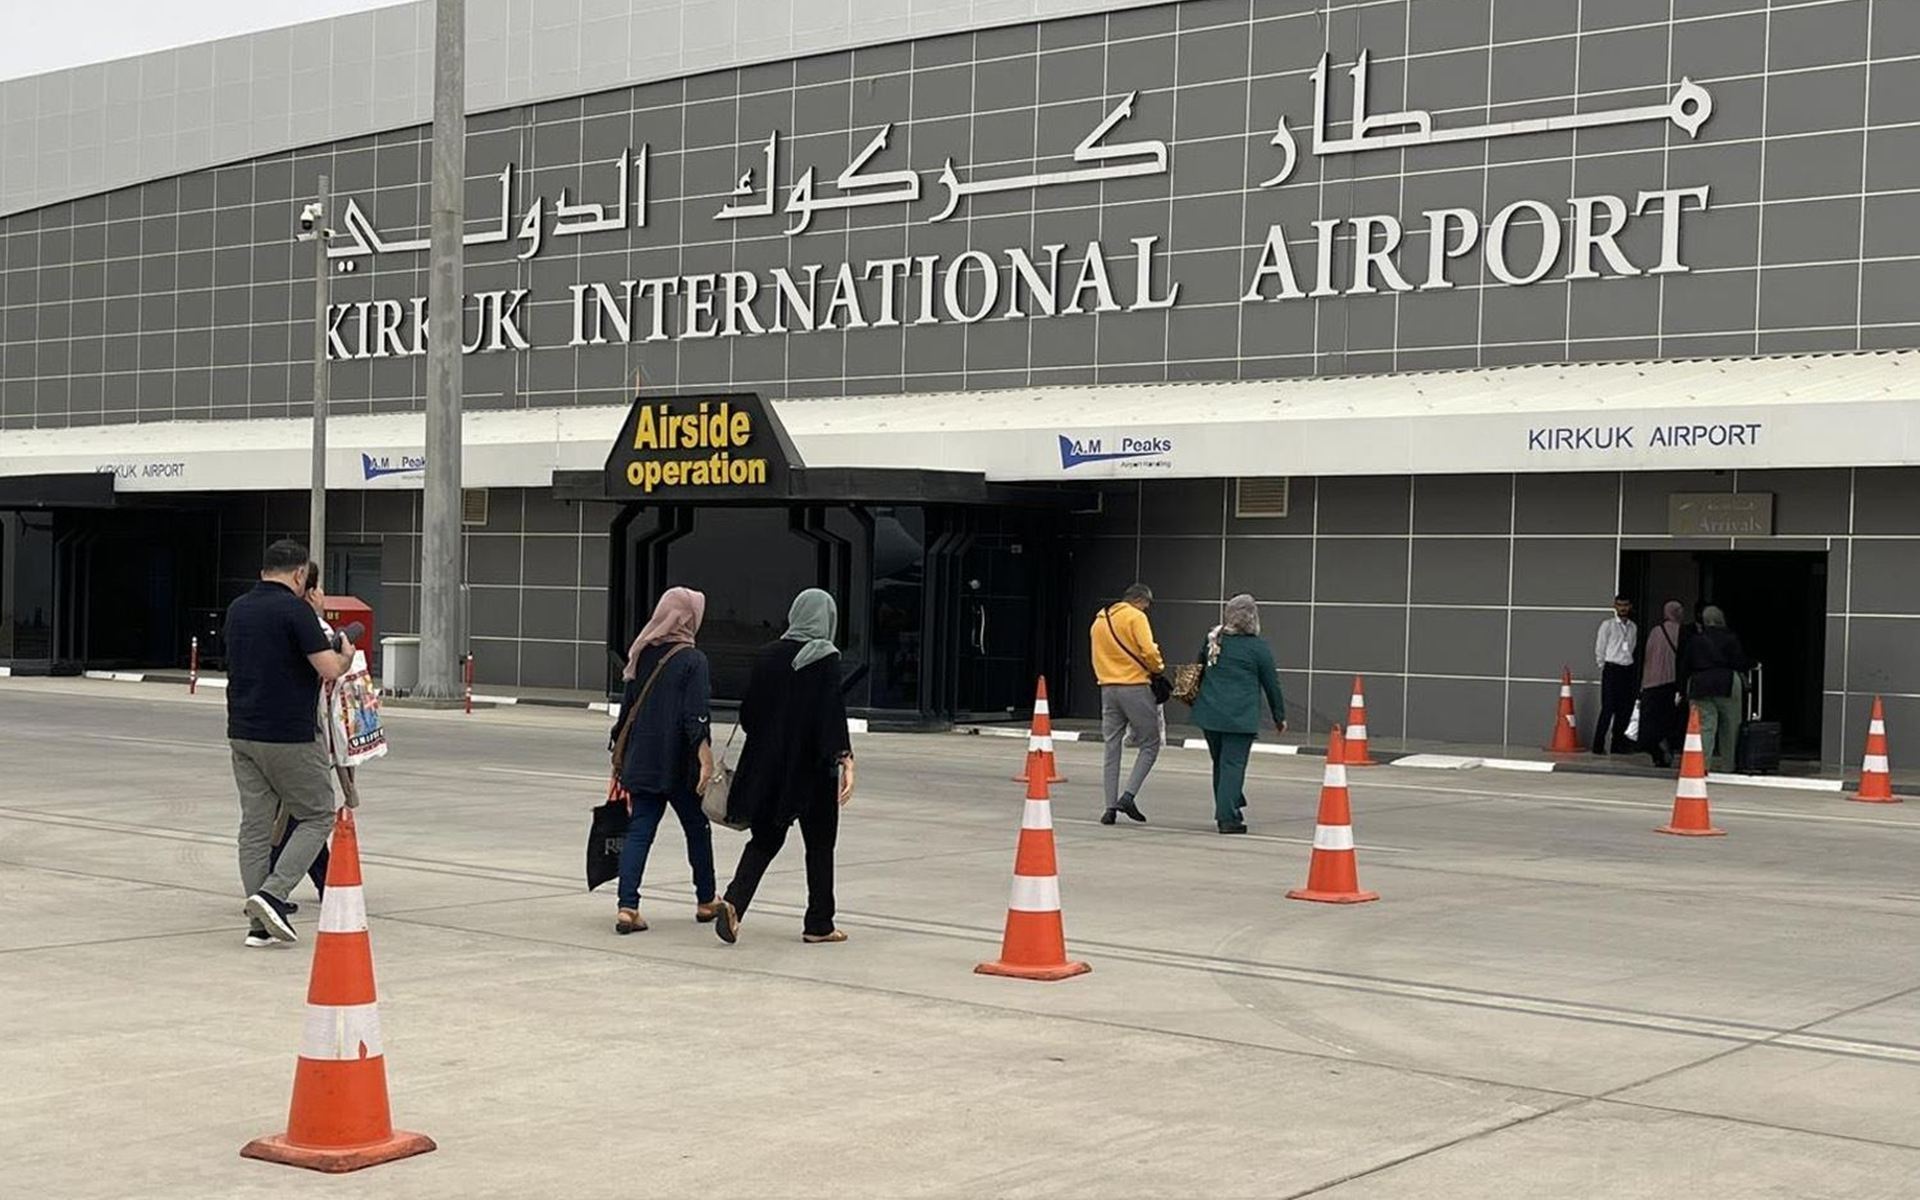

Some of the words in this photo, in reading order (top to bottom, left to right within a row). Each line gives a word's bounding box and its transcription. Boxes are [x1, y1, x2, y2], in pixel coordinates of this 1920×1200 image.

[1260, 48, 1713, 188] مطار
[713, 90, 1169, 236] كركوك
[327, 143, 650, 273] الدولي
[569, 235, 1181, 346] INTERNATIONAL
[1241, 185, 1710, 301] AIRPORT
[633, 402, 751, 450] Airside
[1121, 437, 1172, 452] Peaks
[1528, 426, 1634, 451] KIRKUK
[1649, 424, 1762, 447] AIRPORT
[141, 463, 185, 478] AIRPORT
[627, 452, 767, 493] operation
[1698, 516, 1762, 533] Arrivals
